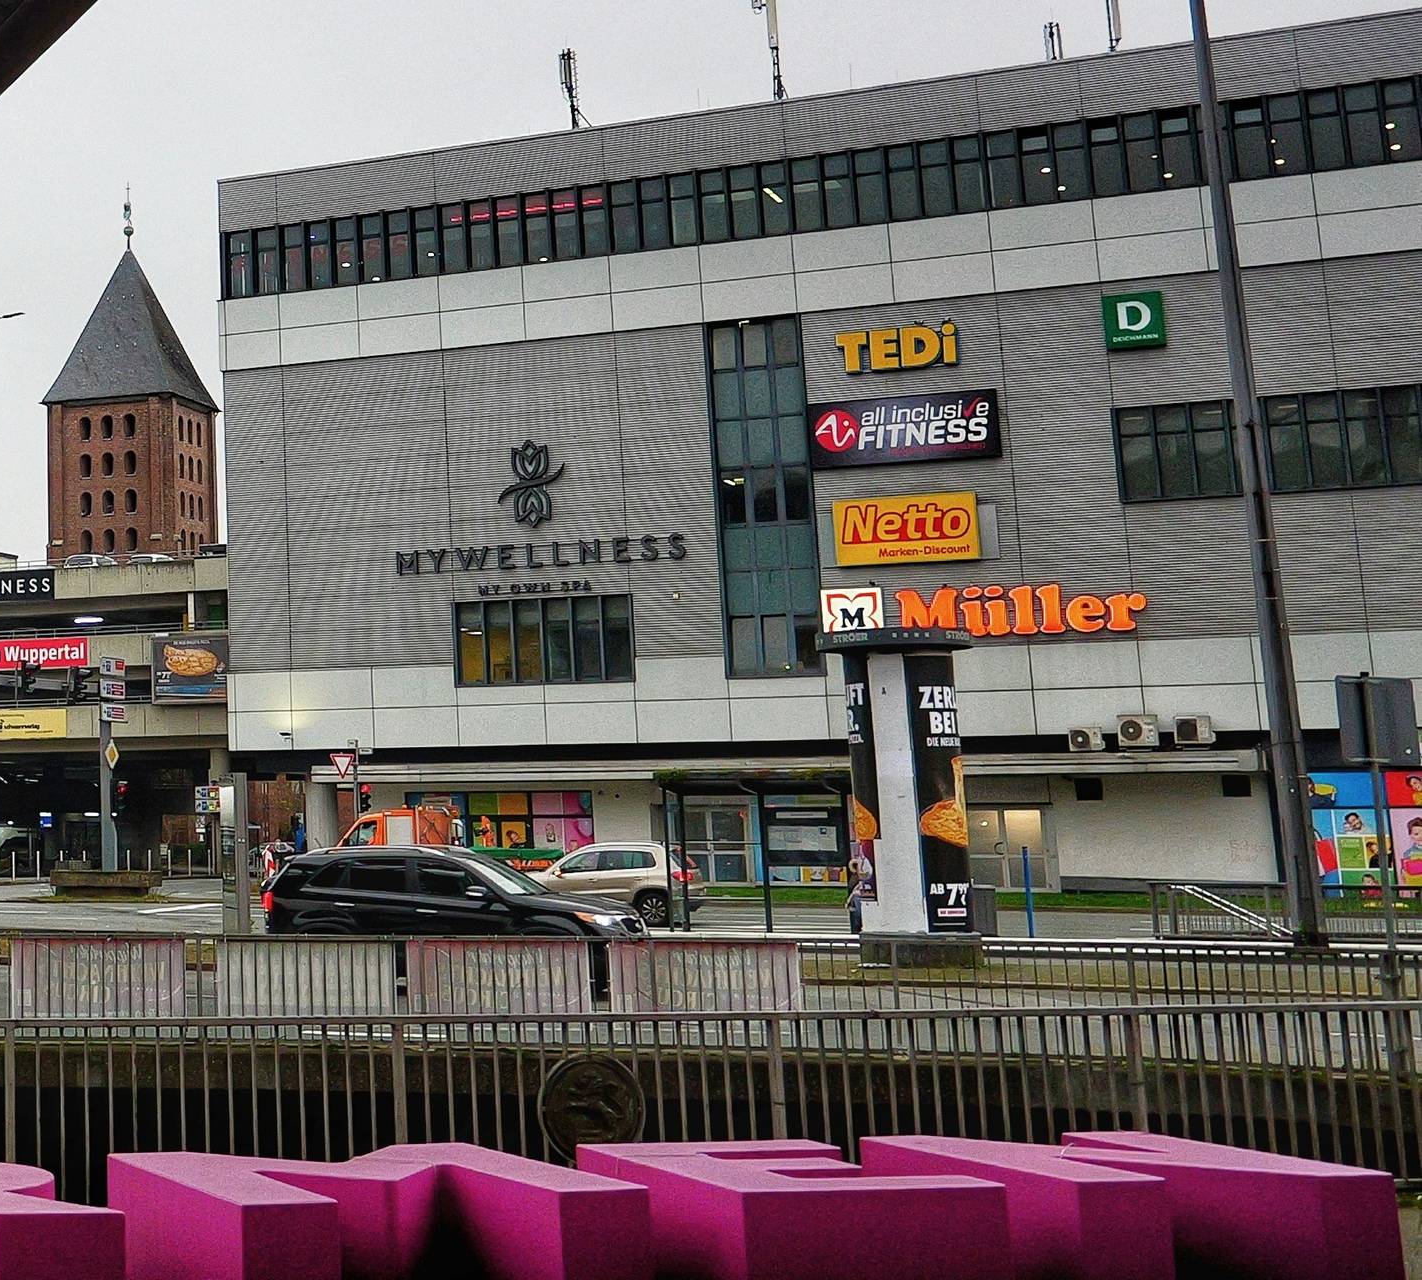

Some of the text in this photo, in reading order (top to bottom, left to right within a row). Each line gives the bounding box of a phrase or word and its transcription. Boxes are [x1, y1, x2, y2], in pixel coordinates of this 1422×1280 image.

[1116, 301, 1151, 331] D
[834, 322, 958, 374] TEDi
[1112, 333, 1159, 343] DEICHMANN
[860, 406, 885, 426] all
[858, 417, 989, 450] FITNESS
[841, 502, 972, 545] Netto
[395, 532, 688, 577] MYWELLNESS
[878, 544, 972, 559] Marken-Discount
[478, 580, 593, 597] MY OWN SPA
[894, 583, 1148, 637] Müller
[4, 642, 85, 666] Wuppertal
[926, 737, 939, 748] DIE
[930, 883, 945, 895] AB
